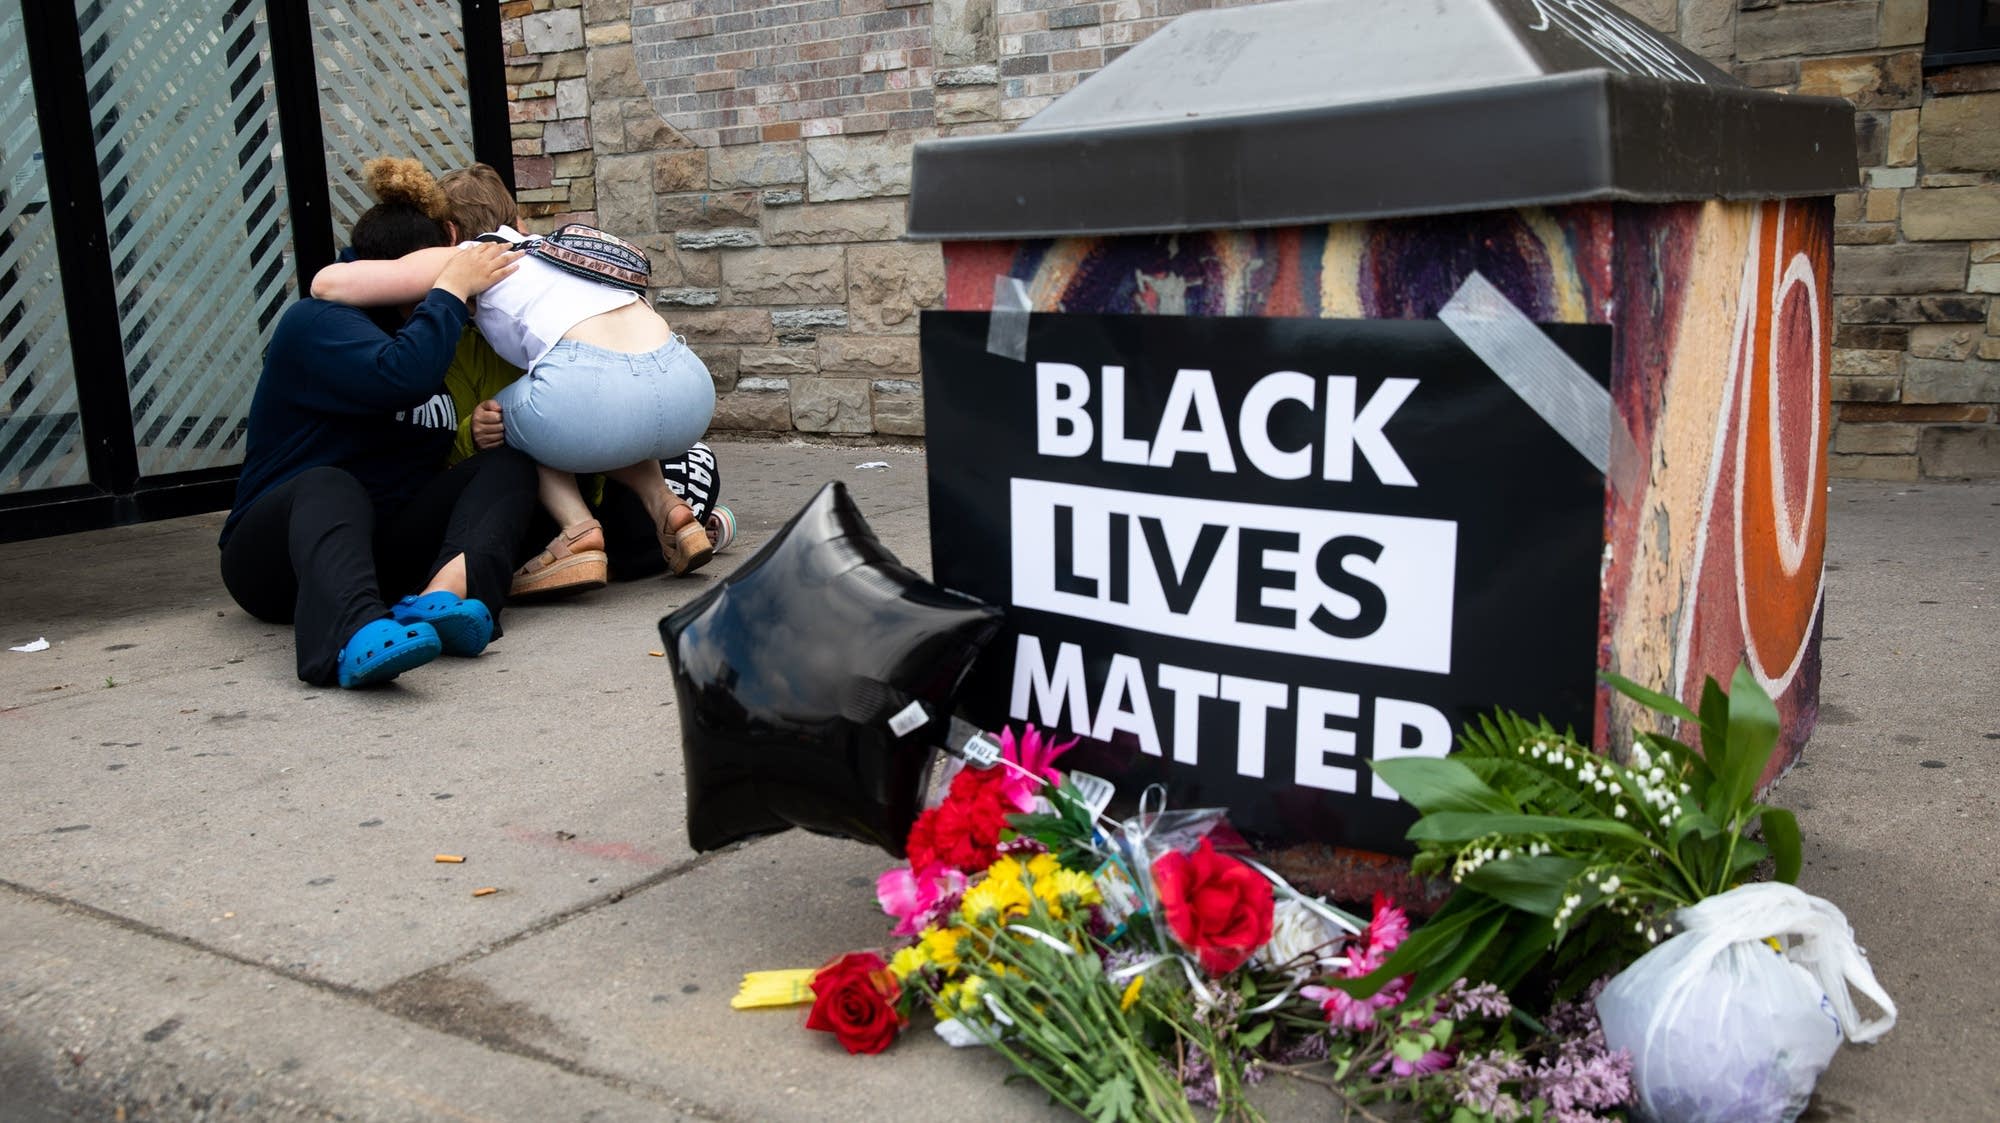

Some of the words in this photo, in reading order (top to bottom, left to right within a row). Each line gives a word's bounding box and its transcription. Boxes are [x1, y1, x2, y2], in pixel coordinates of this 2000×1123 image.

[1036, 362, 1420, 488] BLACK
[1053, 504, 1387, 640] LIVES
[1009, 634, 1453, 801] MATTER
